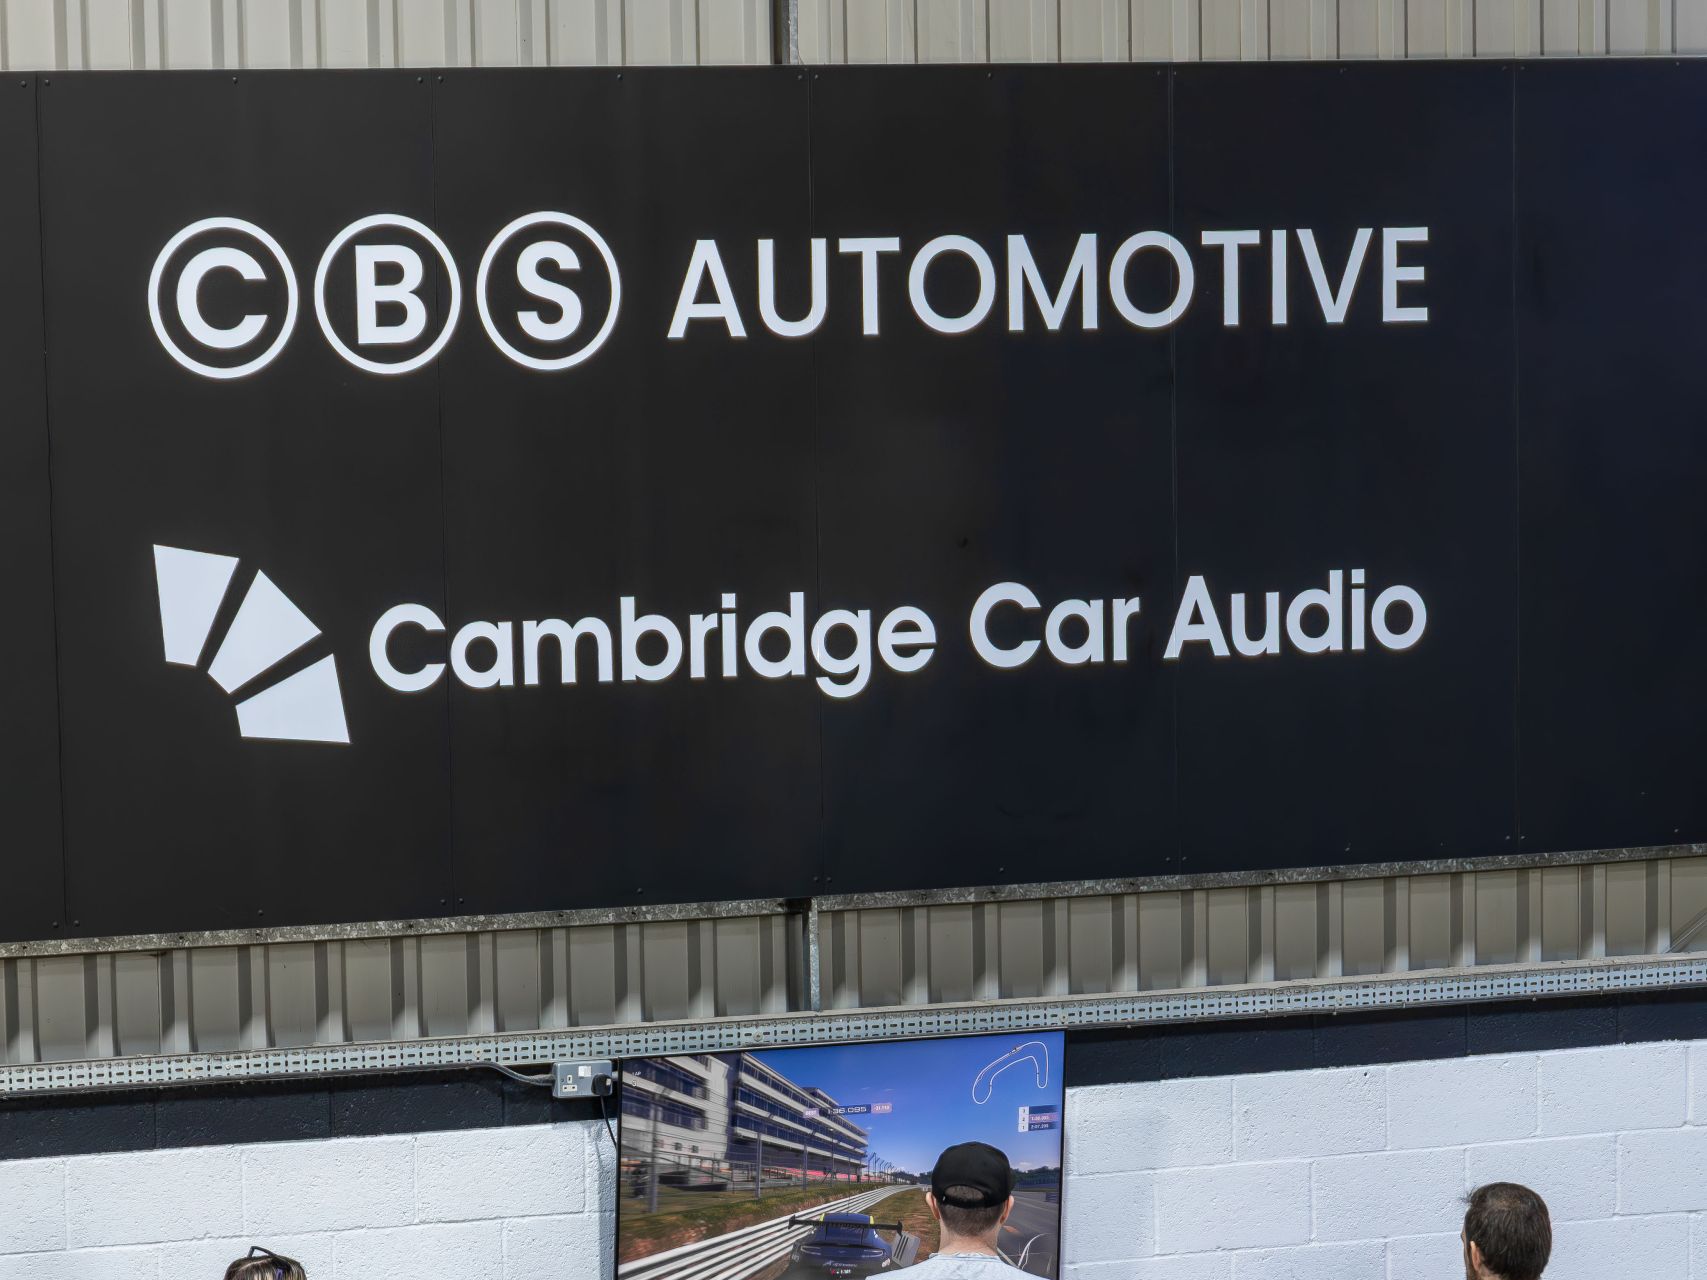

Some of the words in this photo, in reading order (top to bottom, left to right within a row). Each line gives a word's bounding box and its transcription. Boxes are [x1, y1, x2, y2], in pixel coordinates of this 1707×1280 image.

[667, 226, 1430, 339] AUTOMOTIVE
[368, 590, 938, 700] Cambridge
[969, 581, 1141, 669] Car
[1163, 568, 1428, 660] Audio
